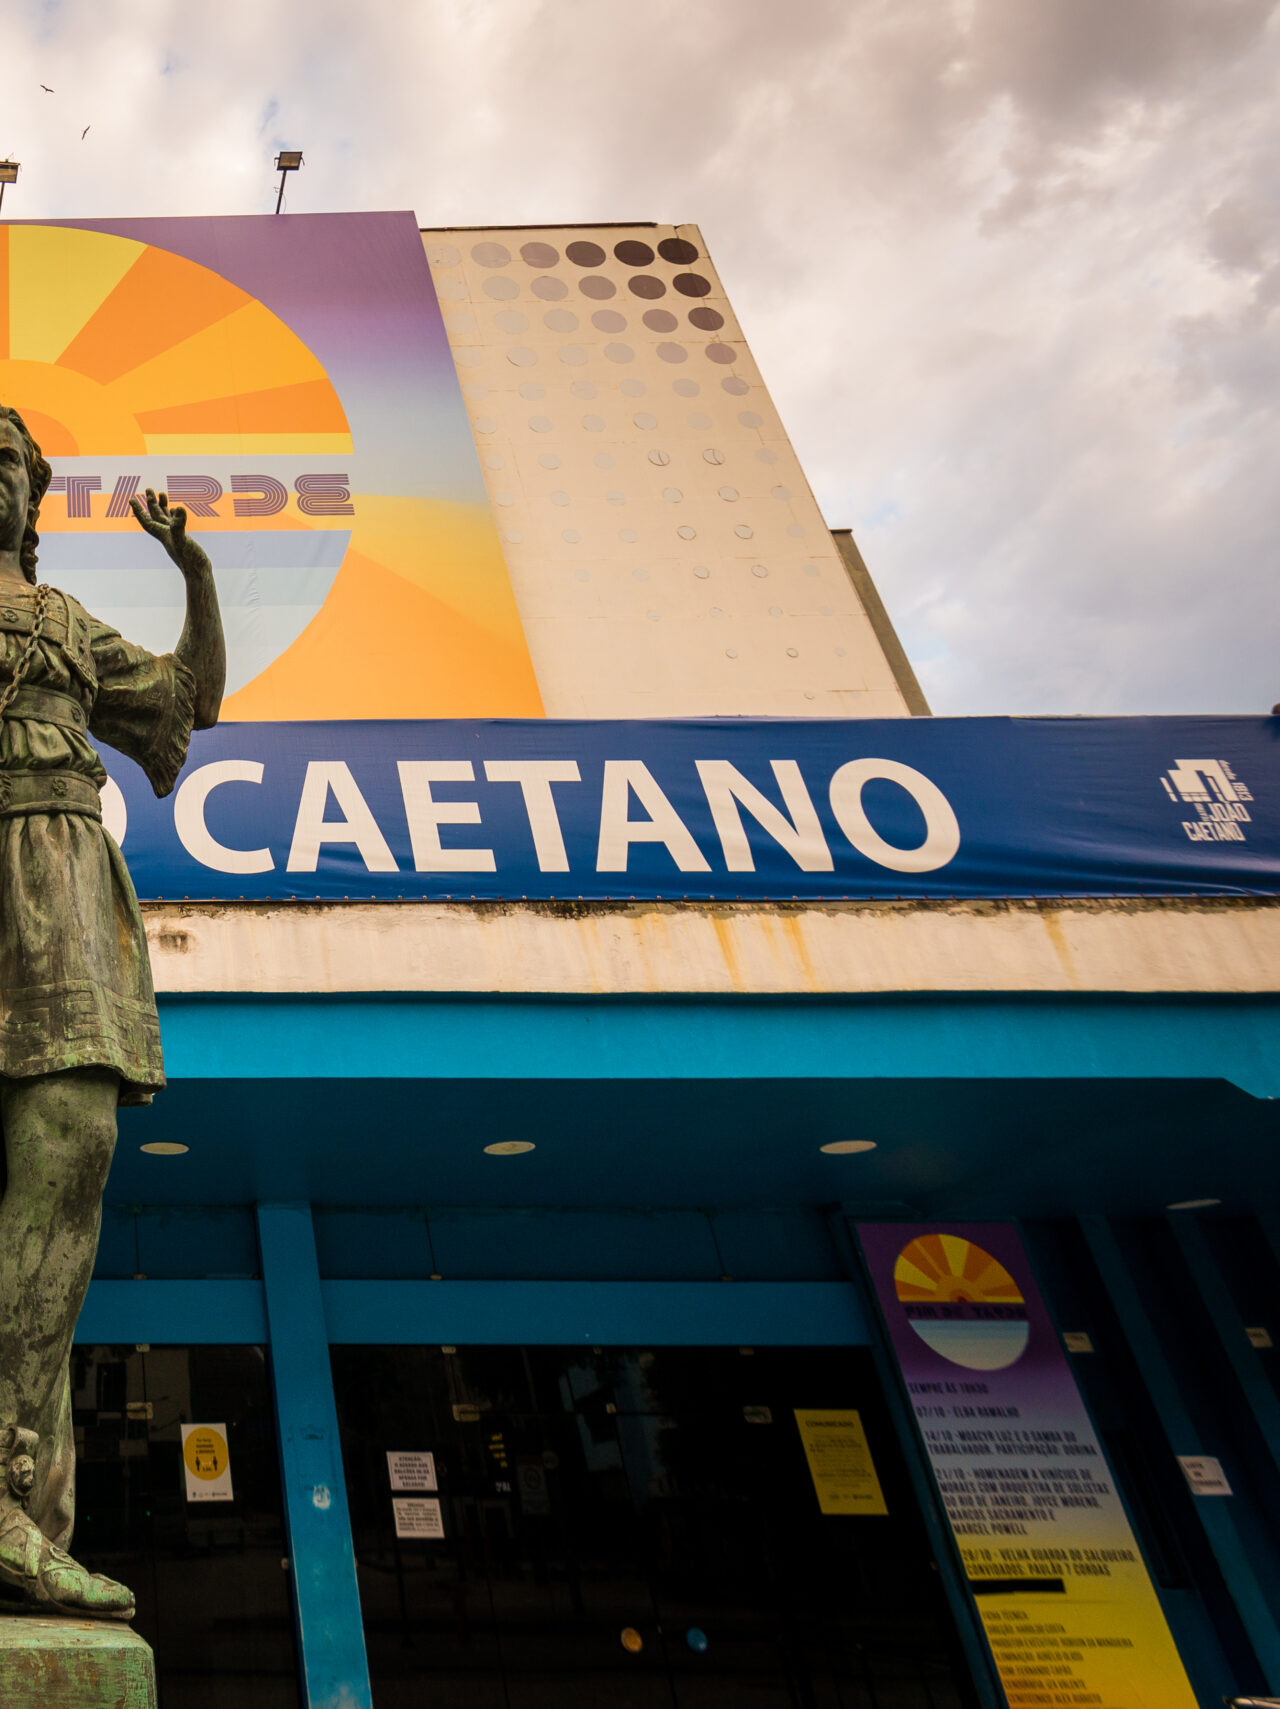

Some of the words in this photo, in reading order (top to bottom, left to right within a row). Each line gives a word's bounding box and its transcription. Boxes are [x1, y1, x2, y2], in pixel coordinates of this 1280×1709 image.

[47, 473, 355, 518] TARDE
[174, 757, 961, 874] CAETANO
[1181, 821, 1247, 841] CAETANO
[907, 1382, 943, 1393] SEMPRE
[914, 1406, 946, 1417] 07/10
[951, 1406, 976, 1417] ELBA
[923, 1430, 953, 1441] 14/10
[1029, 1430, 1063, 1441] SAMBA
[934, 1468, 966, 1479] 21/10
[971, 1468, 1030, 1479] HOMENAGEM
[939, 1481, 977, 1493] MORAES
[976, 1481, 999, 1493] COM
[997, 1481, 1052, 1493] ORQUESTRA
[943, 1495, 958, 1507] DO
[956, 1495, 975, 1507] RIO
[947, 1509, 987, 1520] MARCOS
[986, 1509, 1049, 1520] SACRAMENTO
[952, 1523, 991, 1535] MARCEL
[989, 1523, 1029, 1535] POWELL
[997, 1548, 1032, 1561] VELHA
[1029, 1548, 1070, 1561] GUARDA
